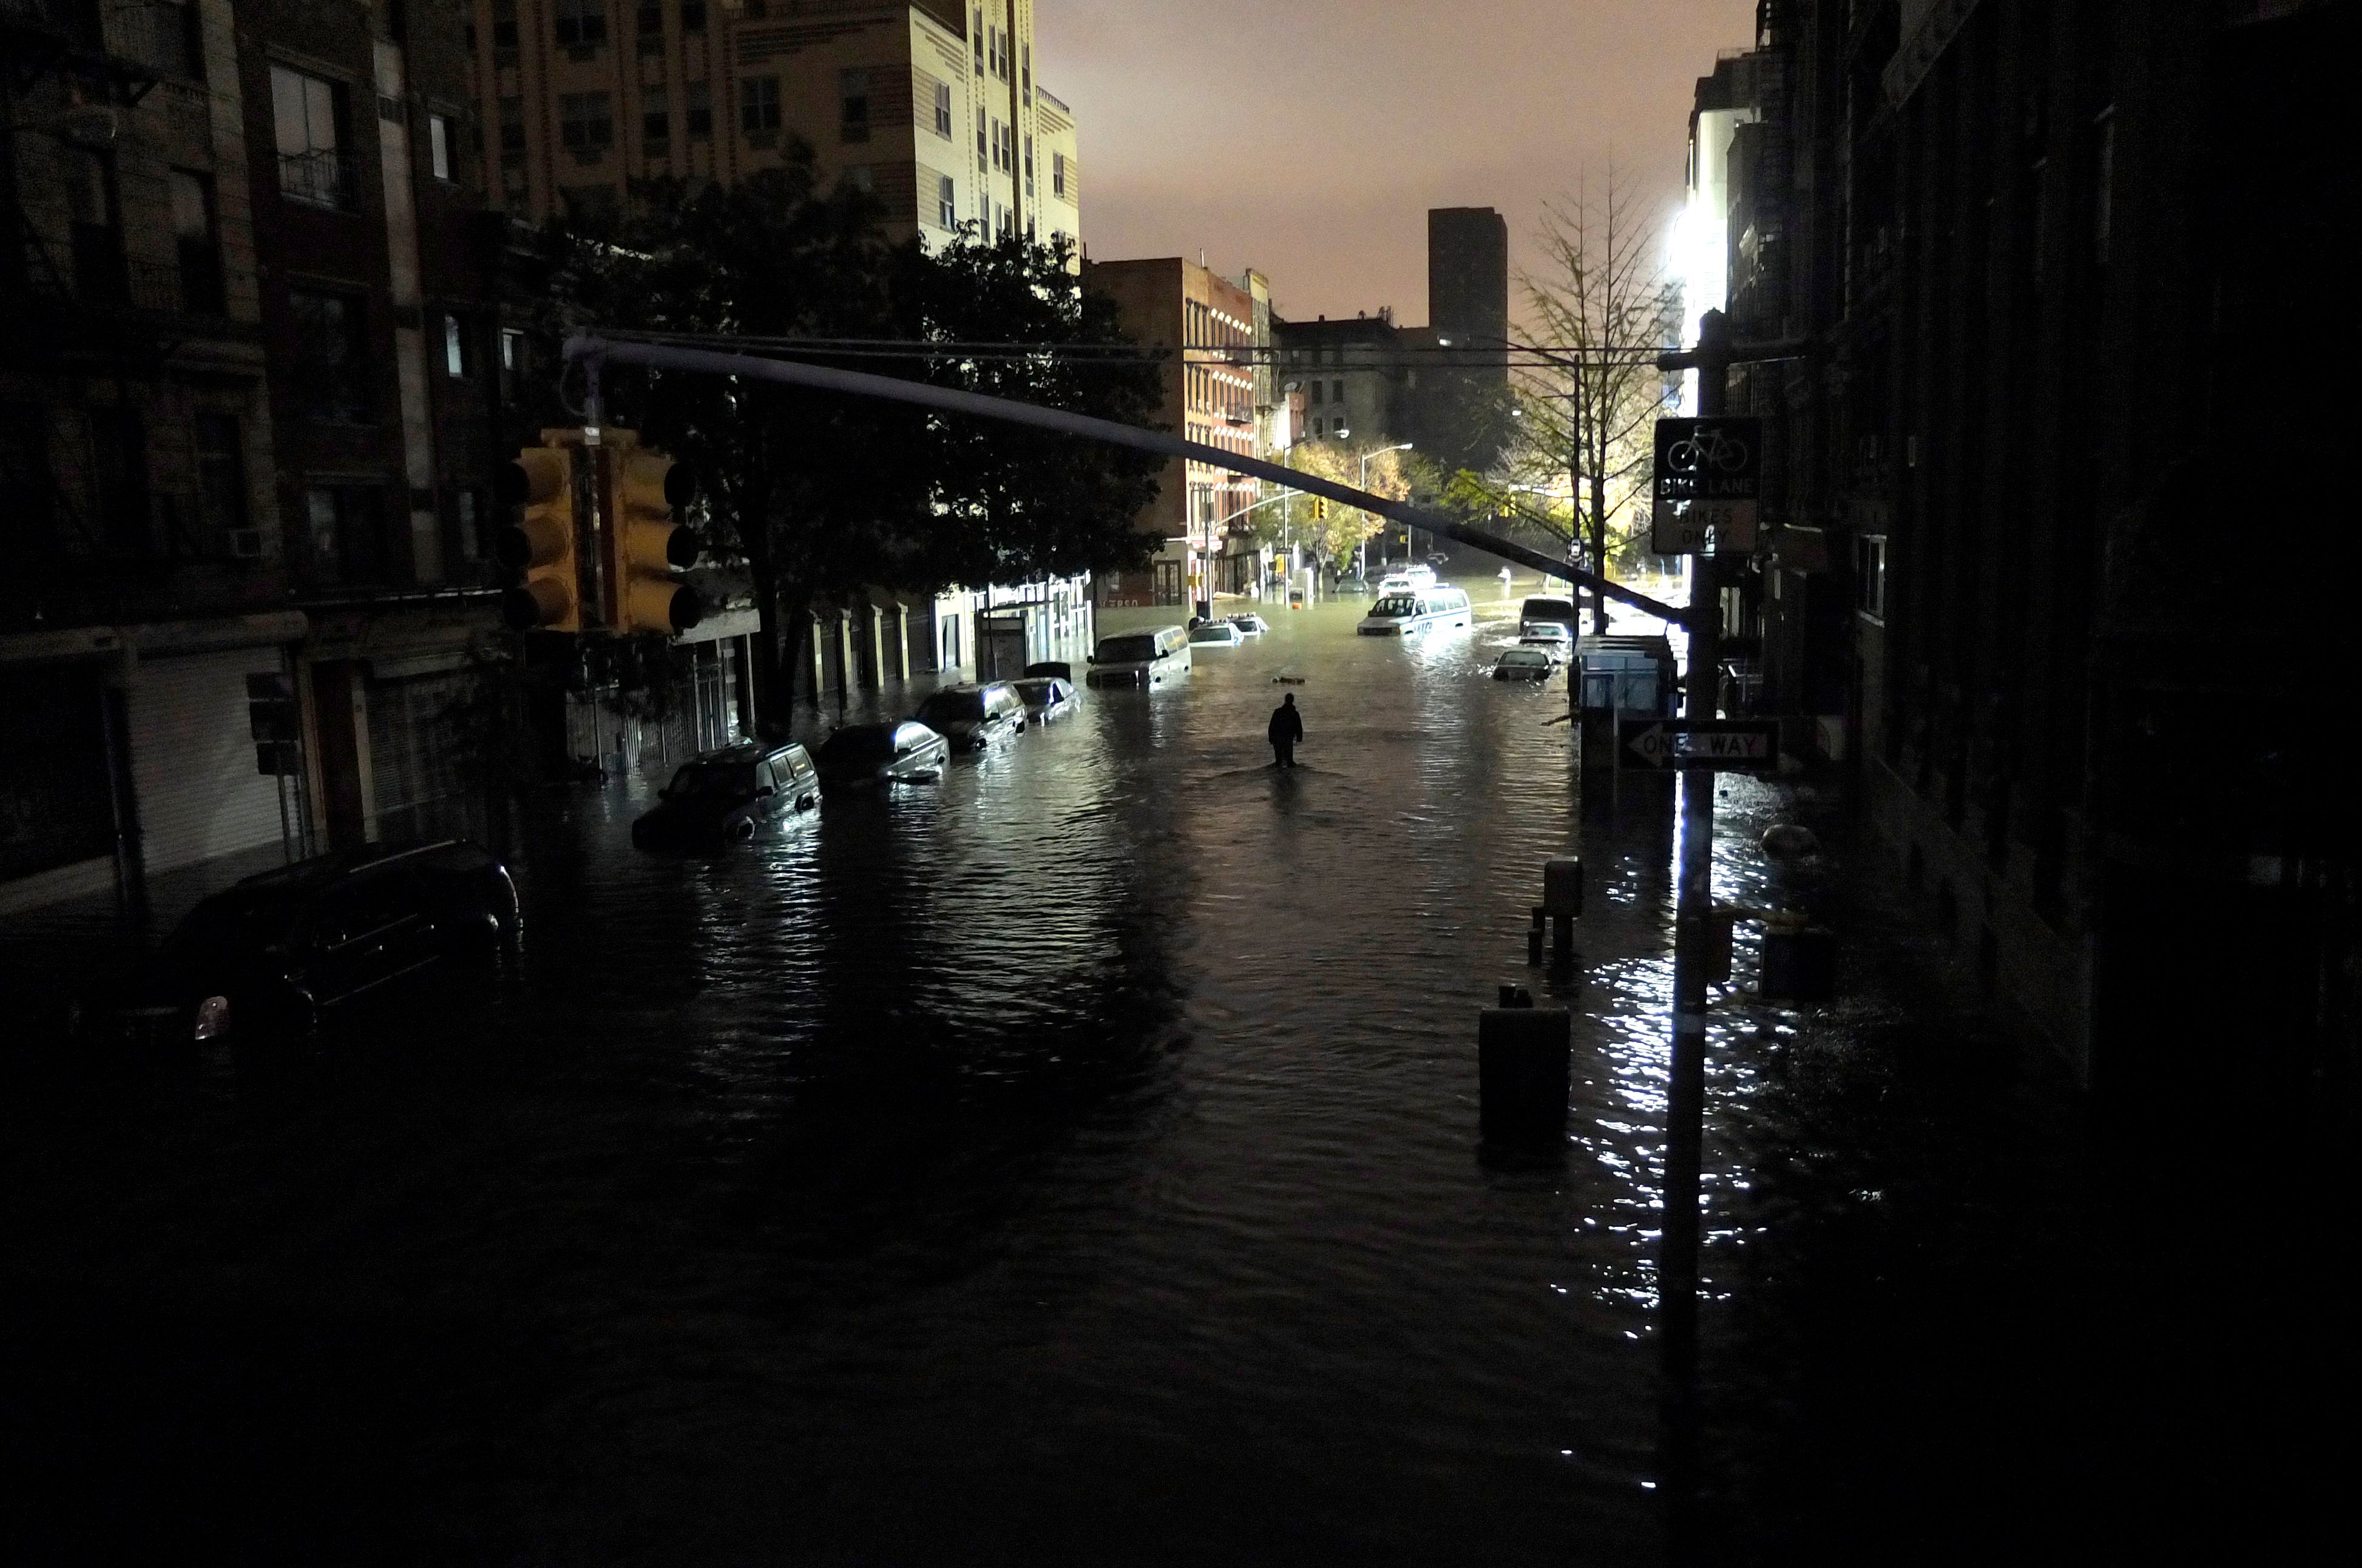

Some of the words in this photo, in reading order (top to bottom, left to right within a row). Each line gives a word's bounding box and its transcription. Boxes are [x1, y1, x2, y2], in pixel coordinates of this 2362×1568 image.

[1660, 478, 1698, 495] BIKE
[1709, 479, 1753, 494] LANE
[1680, 510, 1731, 524] BIKES
[1643, 735, 1688, 754] ONE
[1710, 735, 1757, 754] WAY
